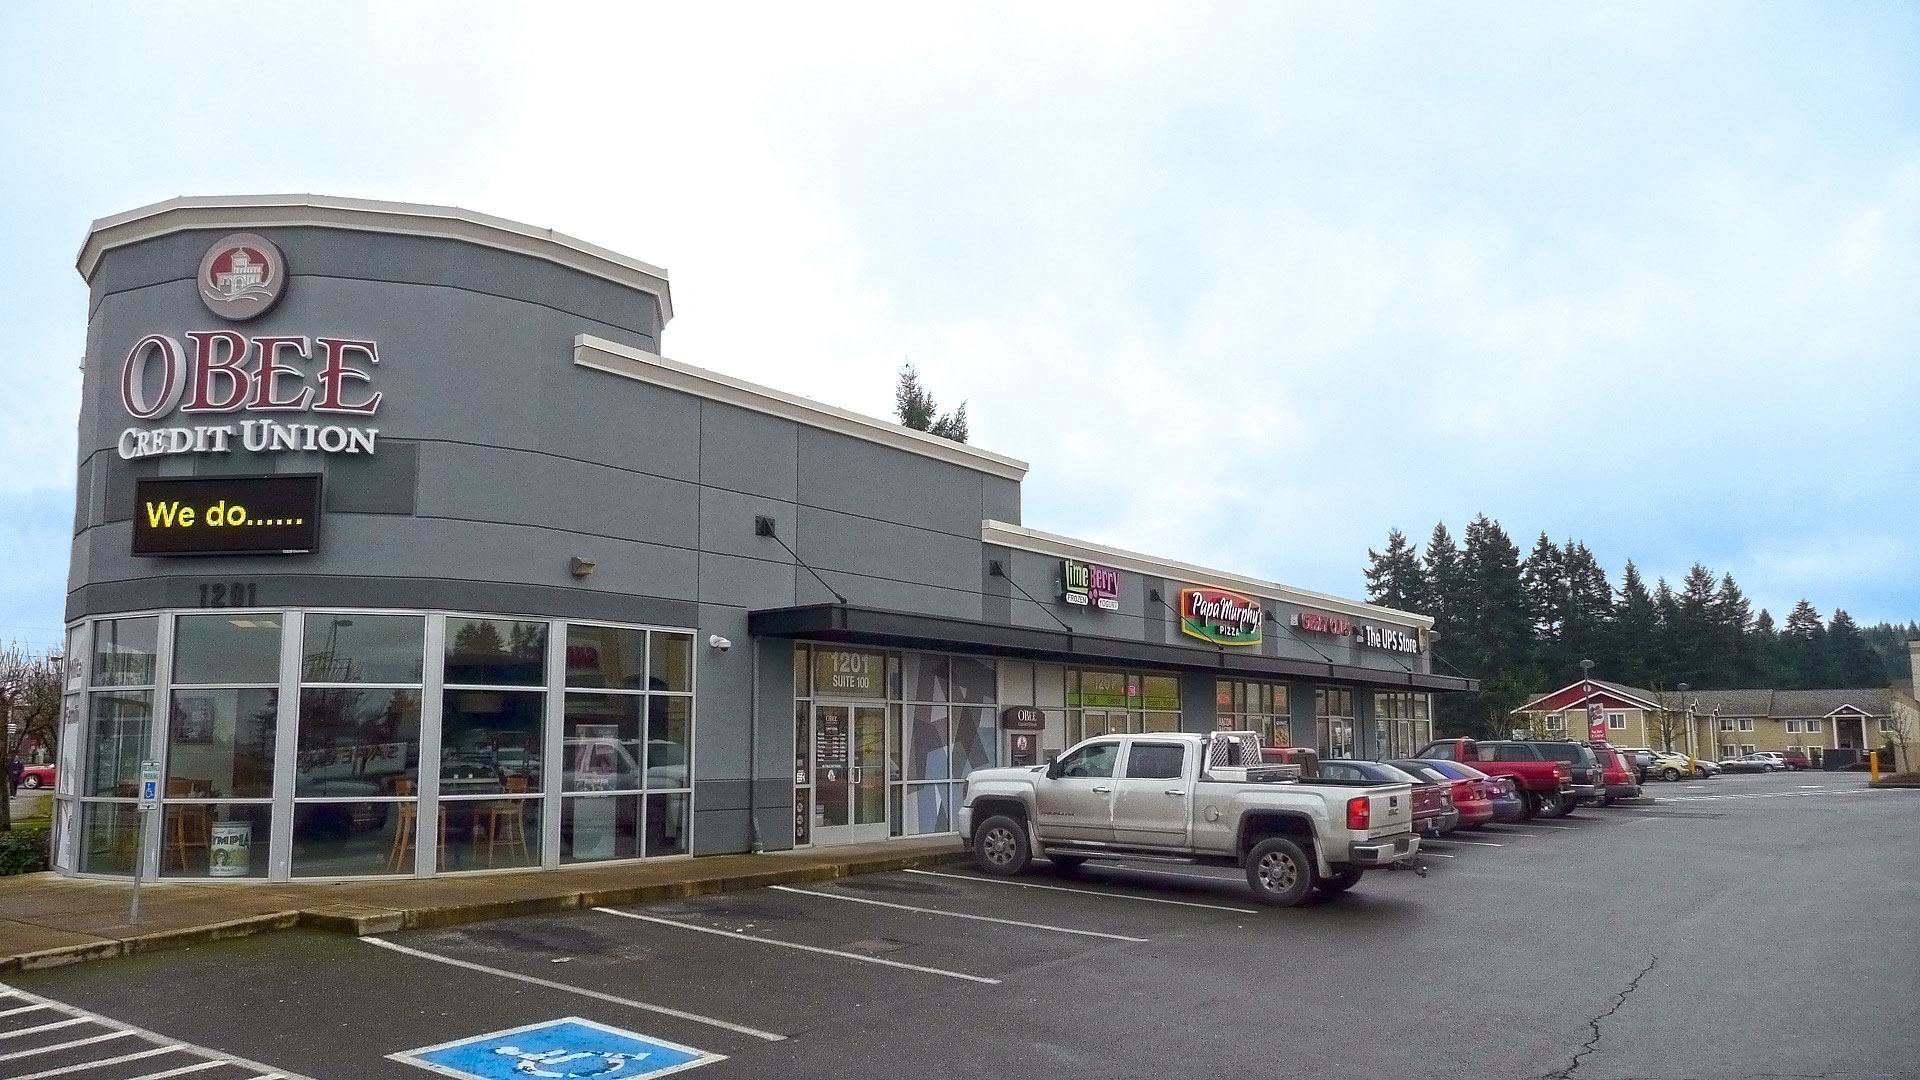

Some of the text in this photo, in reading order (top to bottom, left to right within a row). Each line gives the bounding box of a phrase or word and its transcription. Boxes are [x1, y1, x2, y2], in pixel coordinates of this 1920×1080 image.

[121, 330, 383, 420] OBEE
[118, 419, 379, 459] CREDIT UNION
[146, 501, 195, 528] We
[199, 583, 257, 608] 1201
[1067, 593, 1087, 604] FROZEN
[1193, 591, 1263, 634] Papa Murphy's
[1219, 625, 1240, 637] PIZZA
[1365, 625, 1417, 653] The UPS Store
[831, 652, 868, 673] 1201
[832, 674, 870, 689] SUITE 100
